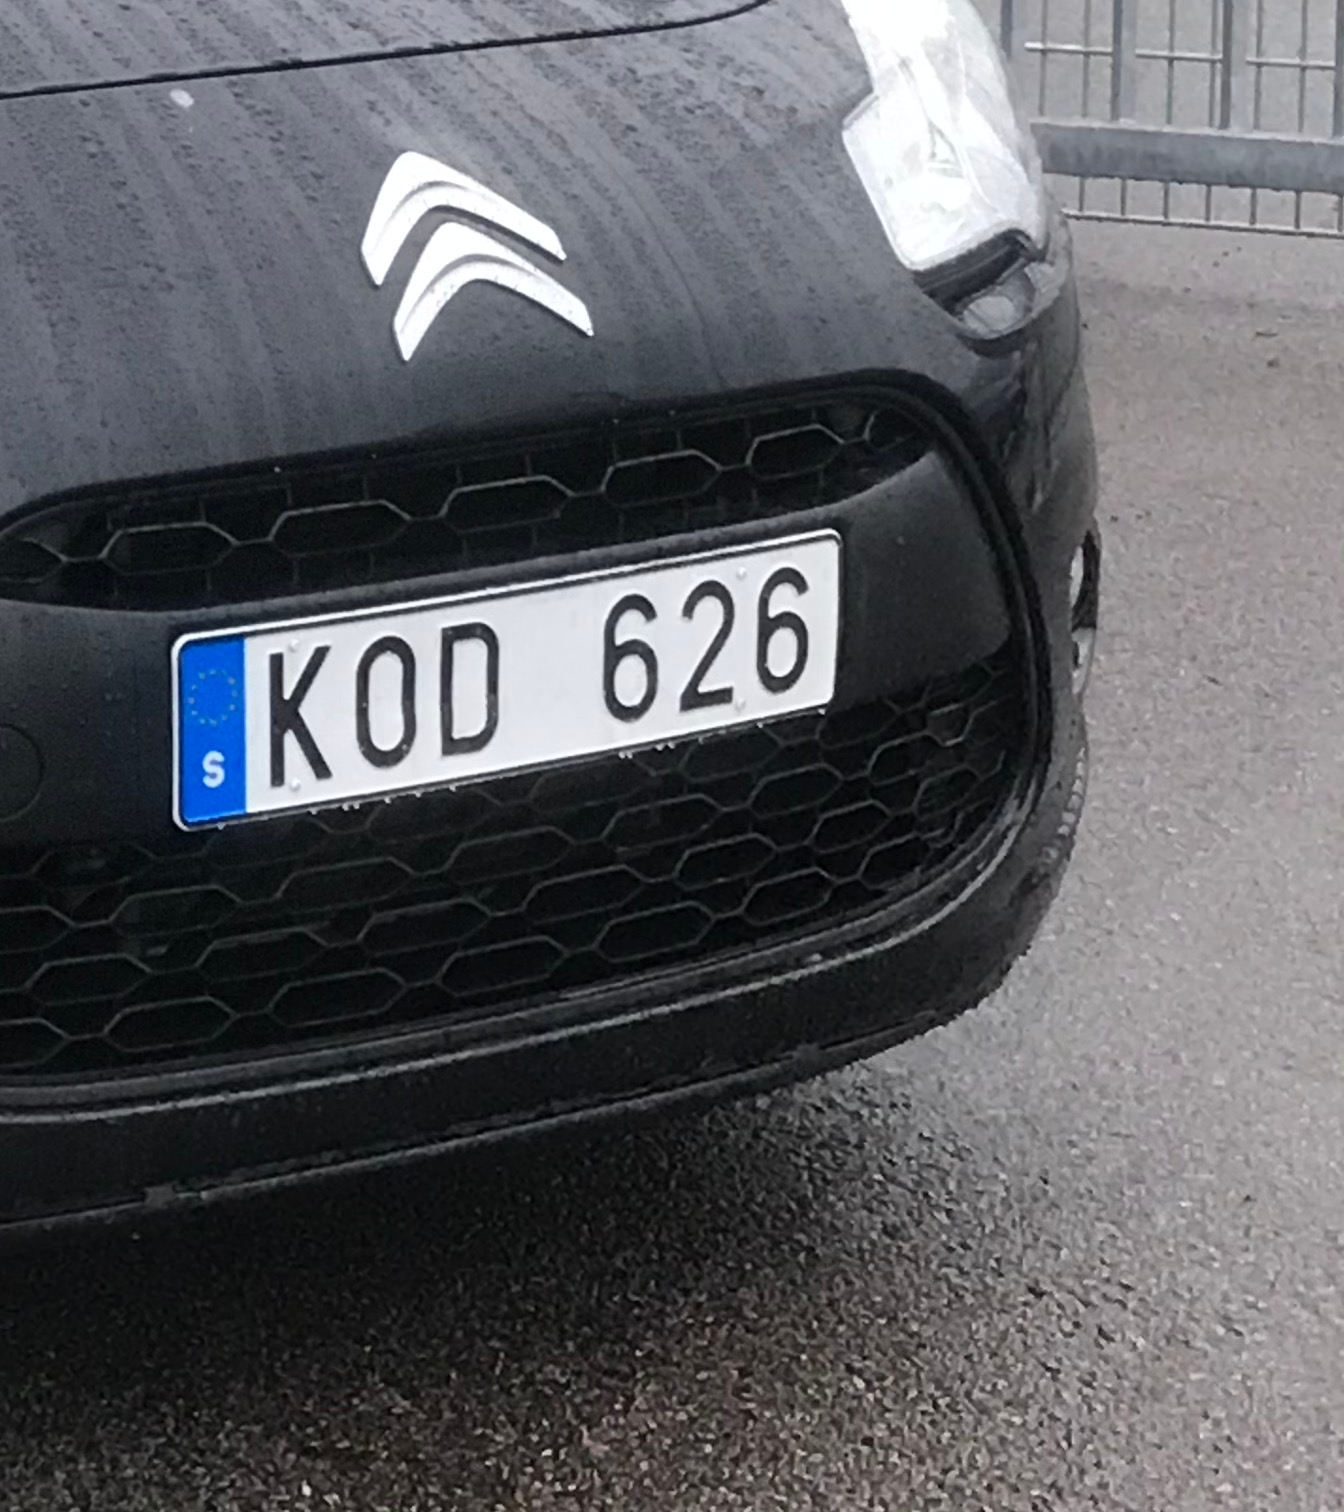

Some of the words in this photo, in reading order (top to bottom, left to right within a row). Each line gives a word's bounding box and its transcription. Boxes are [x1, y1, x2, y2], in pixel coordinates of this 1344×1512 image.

[267, 621, 501, 790] KOD
[602, 566, 810, 724] 626
[202, 750, 225, 788] S
